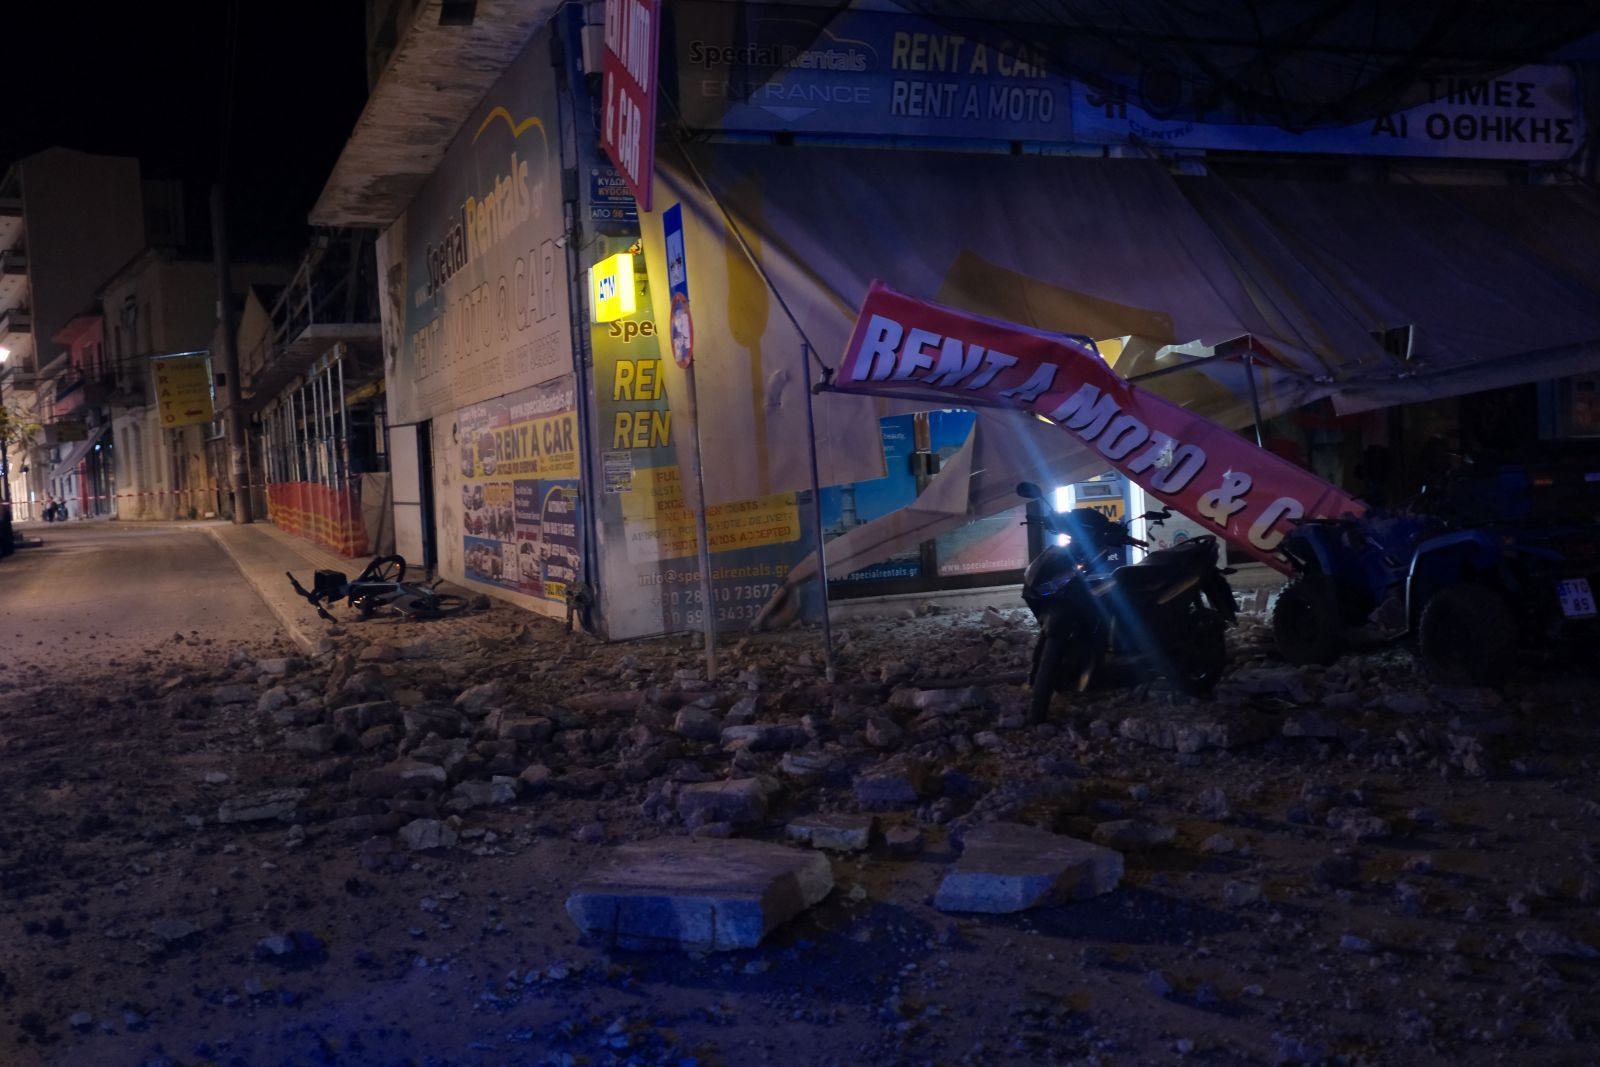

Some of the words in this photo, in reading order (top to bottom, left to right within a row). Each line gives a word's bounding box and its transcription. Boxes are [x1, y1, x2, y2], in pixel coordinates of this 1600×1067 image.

[891, 30, 965, 73] RENT
[968, 36, 989, 75] A
[996, 39, 1048, 79] CAR
[702, 79, 872, 104] ENTRANCE
[889, 80, 958, 117] RENT
[962, 85, 979, 120] A
[987, 86, 1055, 124] MOTO
[618, 87, 641, 187] CAR
[515, 237, 558, 332] CAR
[155, 362, 175, 424] PRATO
[495, 424, 528, 462] RENT
[531, 423, 540, 457] A
[543, 416, 574, 455] CAR
[613, 409, 672, 450] REN
[852, 312, 1019, 391] RENT
[999, 362, 1060, 403] A
[1047, 381, 1209, 495] MOTO
[1196, 468, 1254, 530] &
[1245, 496, 1306, 555] C
[656, 471, 680, 484] FUL
